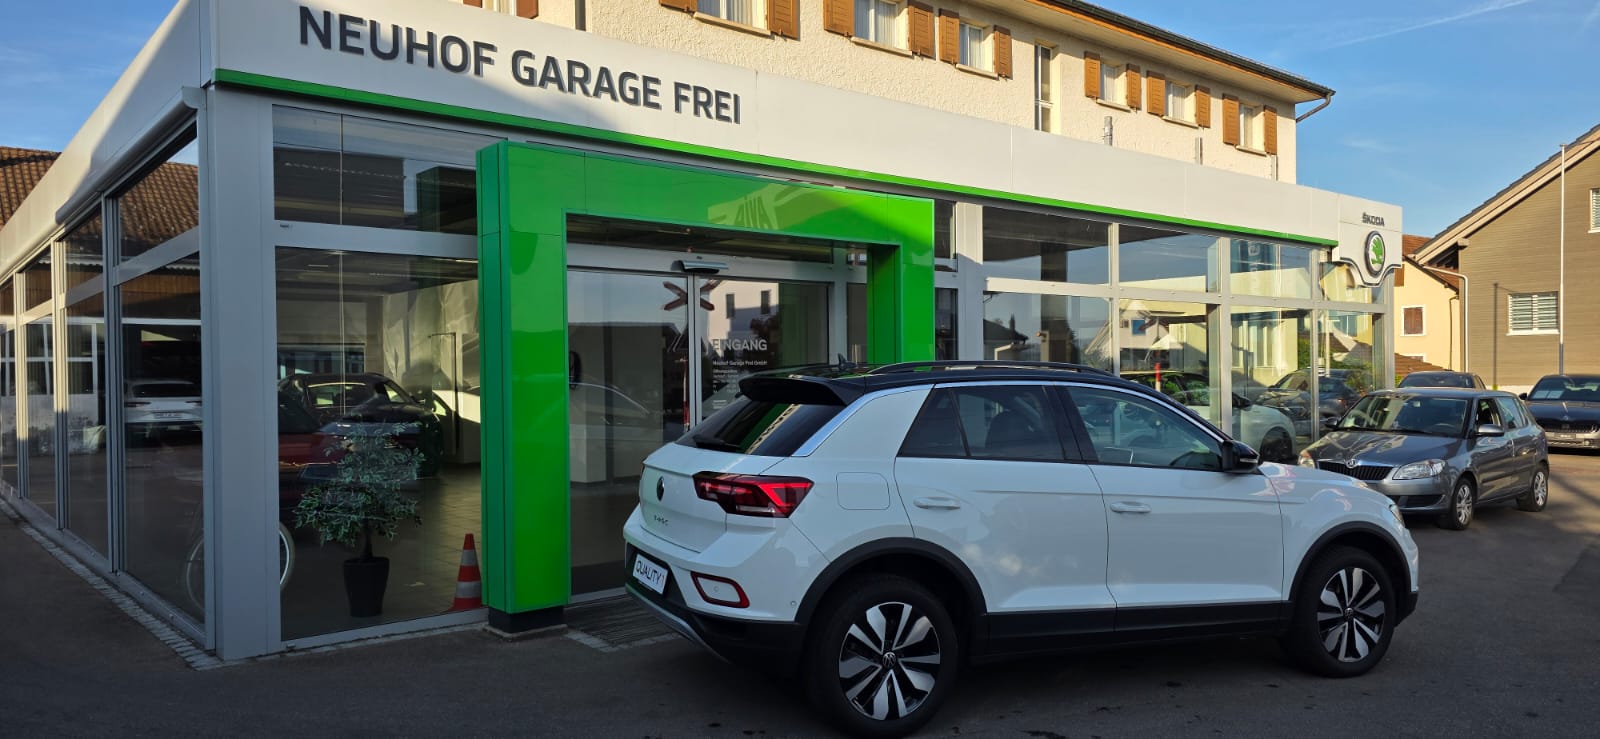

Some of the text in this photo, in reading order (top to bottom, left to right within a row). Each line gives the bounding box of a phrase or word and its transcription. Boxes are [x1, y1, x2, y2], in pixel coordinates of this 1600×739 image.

[299, 6, 741, 124] NEUHOF GARAGE FREI
